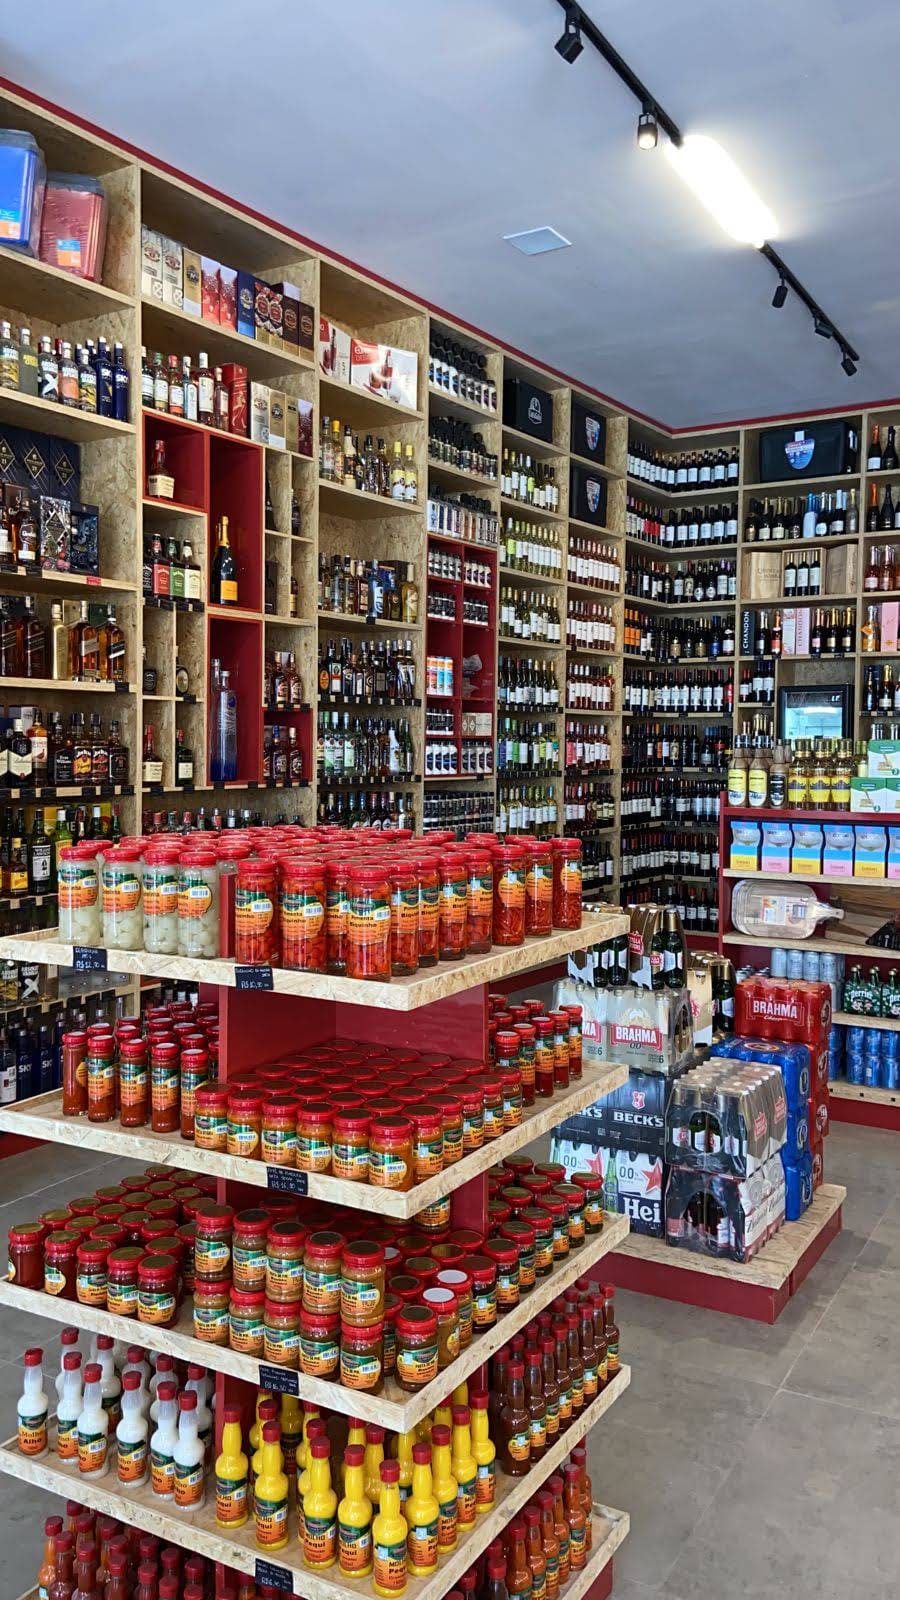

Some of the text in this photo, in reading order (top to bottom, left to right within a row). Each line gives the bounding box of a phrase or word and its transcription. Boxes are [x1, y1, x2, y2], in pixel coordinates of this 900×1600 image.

[753, 1000, 798, 1019] BRAHMA
[615, 1026, 657, 1044] BRAHMA
[576, 1107, 603, 1118] K'S
[613, 1112, 664, 1128] BECK'S
[622, 1197, 662, 1223] Hei
